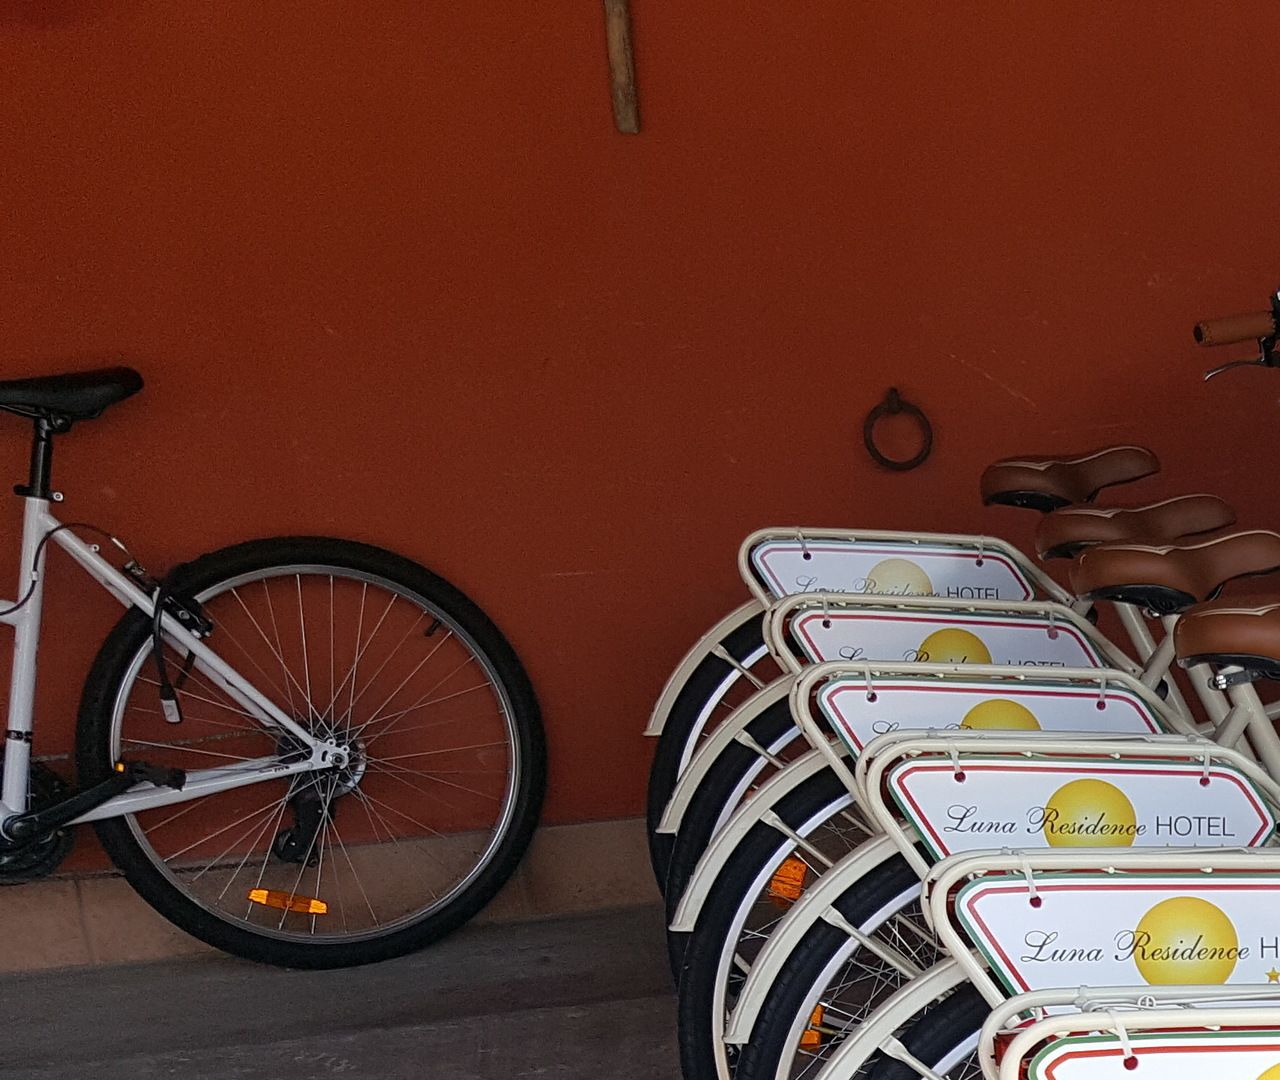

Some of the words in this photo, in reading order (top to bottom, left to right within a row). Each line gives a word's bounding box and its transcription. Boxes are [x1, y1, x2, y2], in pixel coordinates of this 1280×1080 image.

[943, 804, 1018, 834] Luna
[1026, 806, 1147, 836] Residence
[1155, 815, 1236, 837] HOTEL
[1020, 930, 1104, 962] Luna
[1113, 929, 1250, 962] Residence
